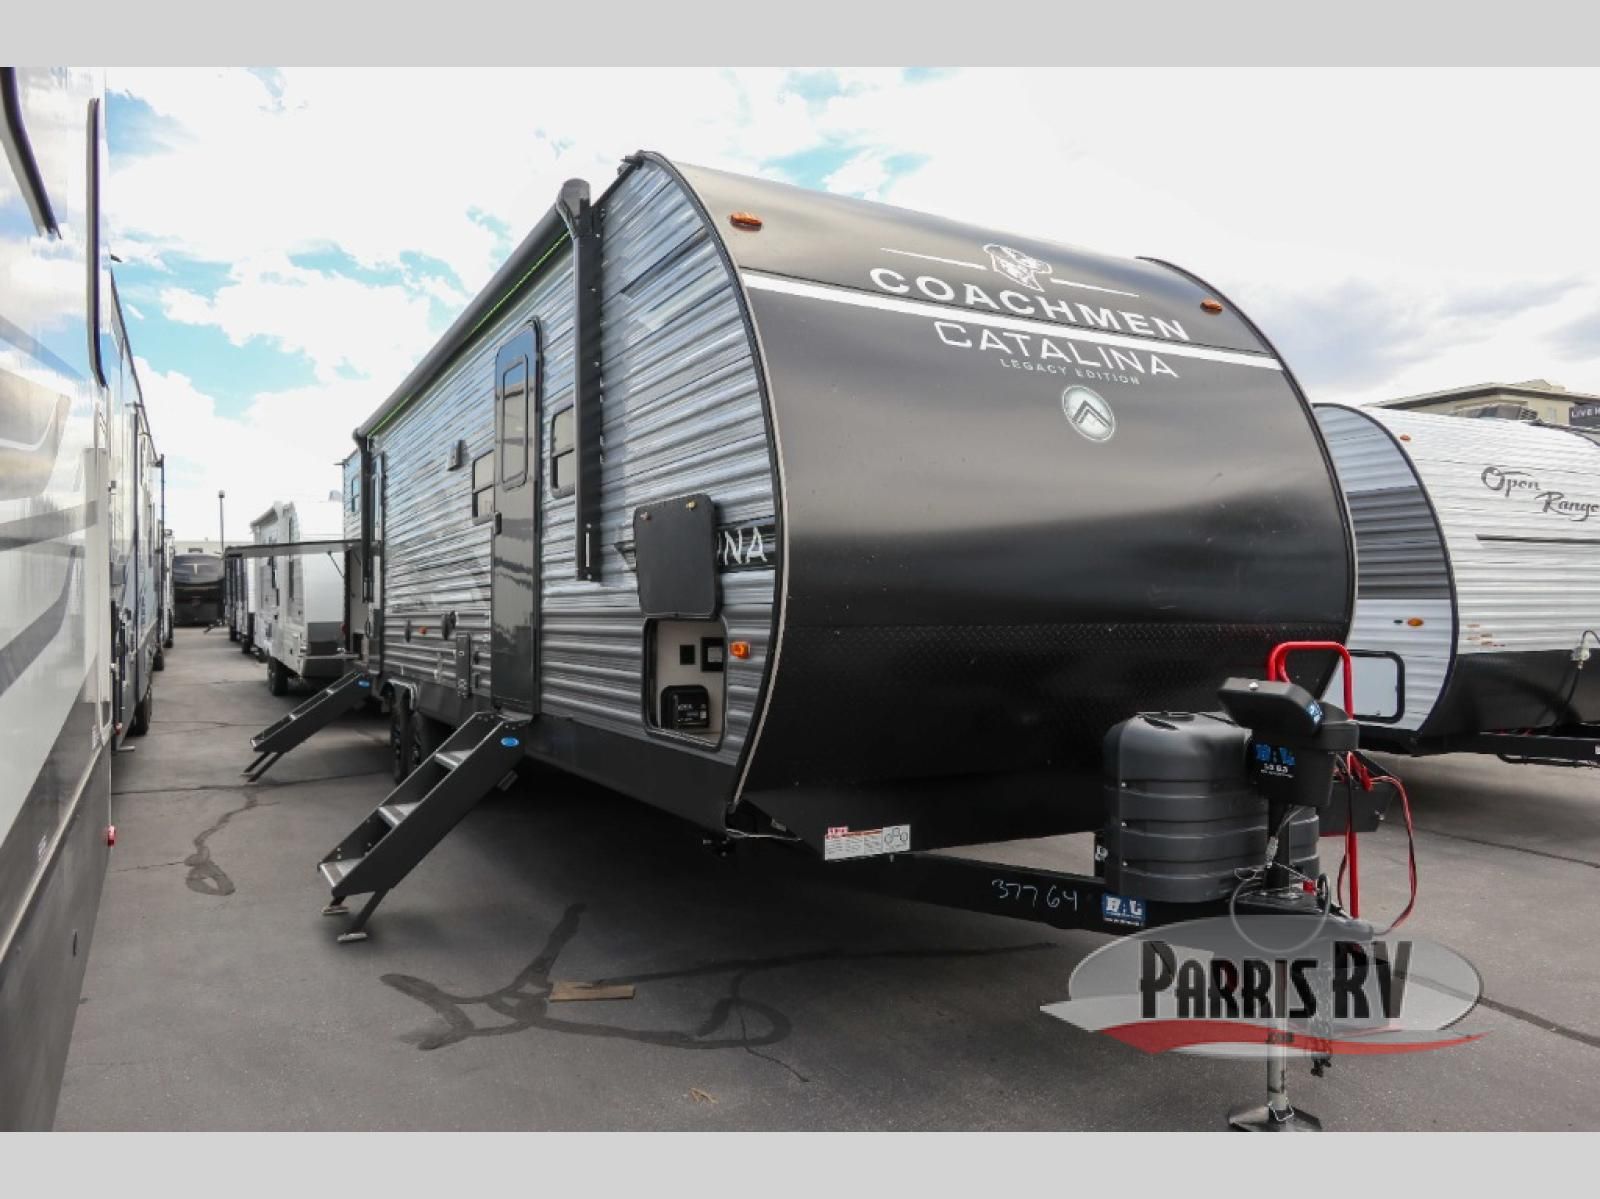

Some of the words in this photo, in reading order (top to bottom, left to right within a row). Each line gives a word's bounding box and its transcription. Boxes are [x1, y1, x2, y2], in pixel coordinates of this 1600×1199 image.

[869, 268, 1191, 341] COACHMEN
[934, 320, 1180, 379] CATALINA
[1000, 358, 1067, 375] LEGACY
[1075, 368, 1140, 385] EDITION
[1481, 466, 1541, 498] Open
[1534, 491, 1600, 522] Range
